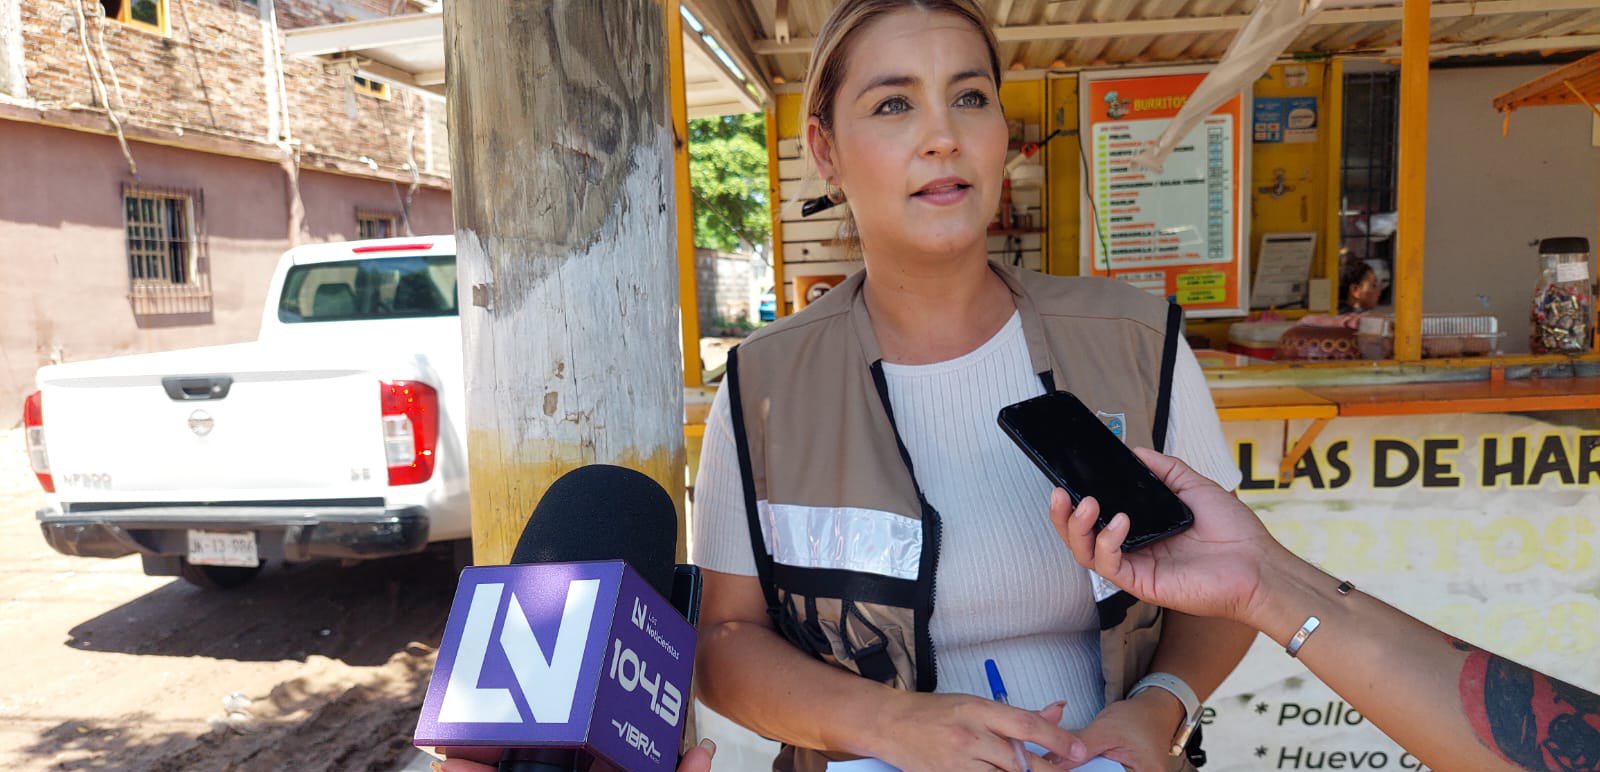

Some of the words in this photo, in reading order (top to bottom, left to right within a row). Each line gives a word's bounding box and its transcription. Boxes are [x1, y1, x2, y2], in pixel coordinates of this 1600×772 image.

[1374, 440, 1460, 488] DE
[610, 637, 682, 727] 104.3
[1277, 702, 1364, 727] Pollo
[1277, 747, 1388, 769] Huevo
